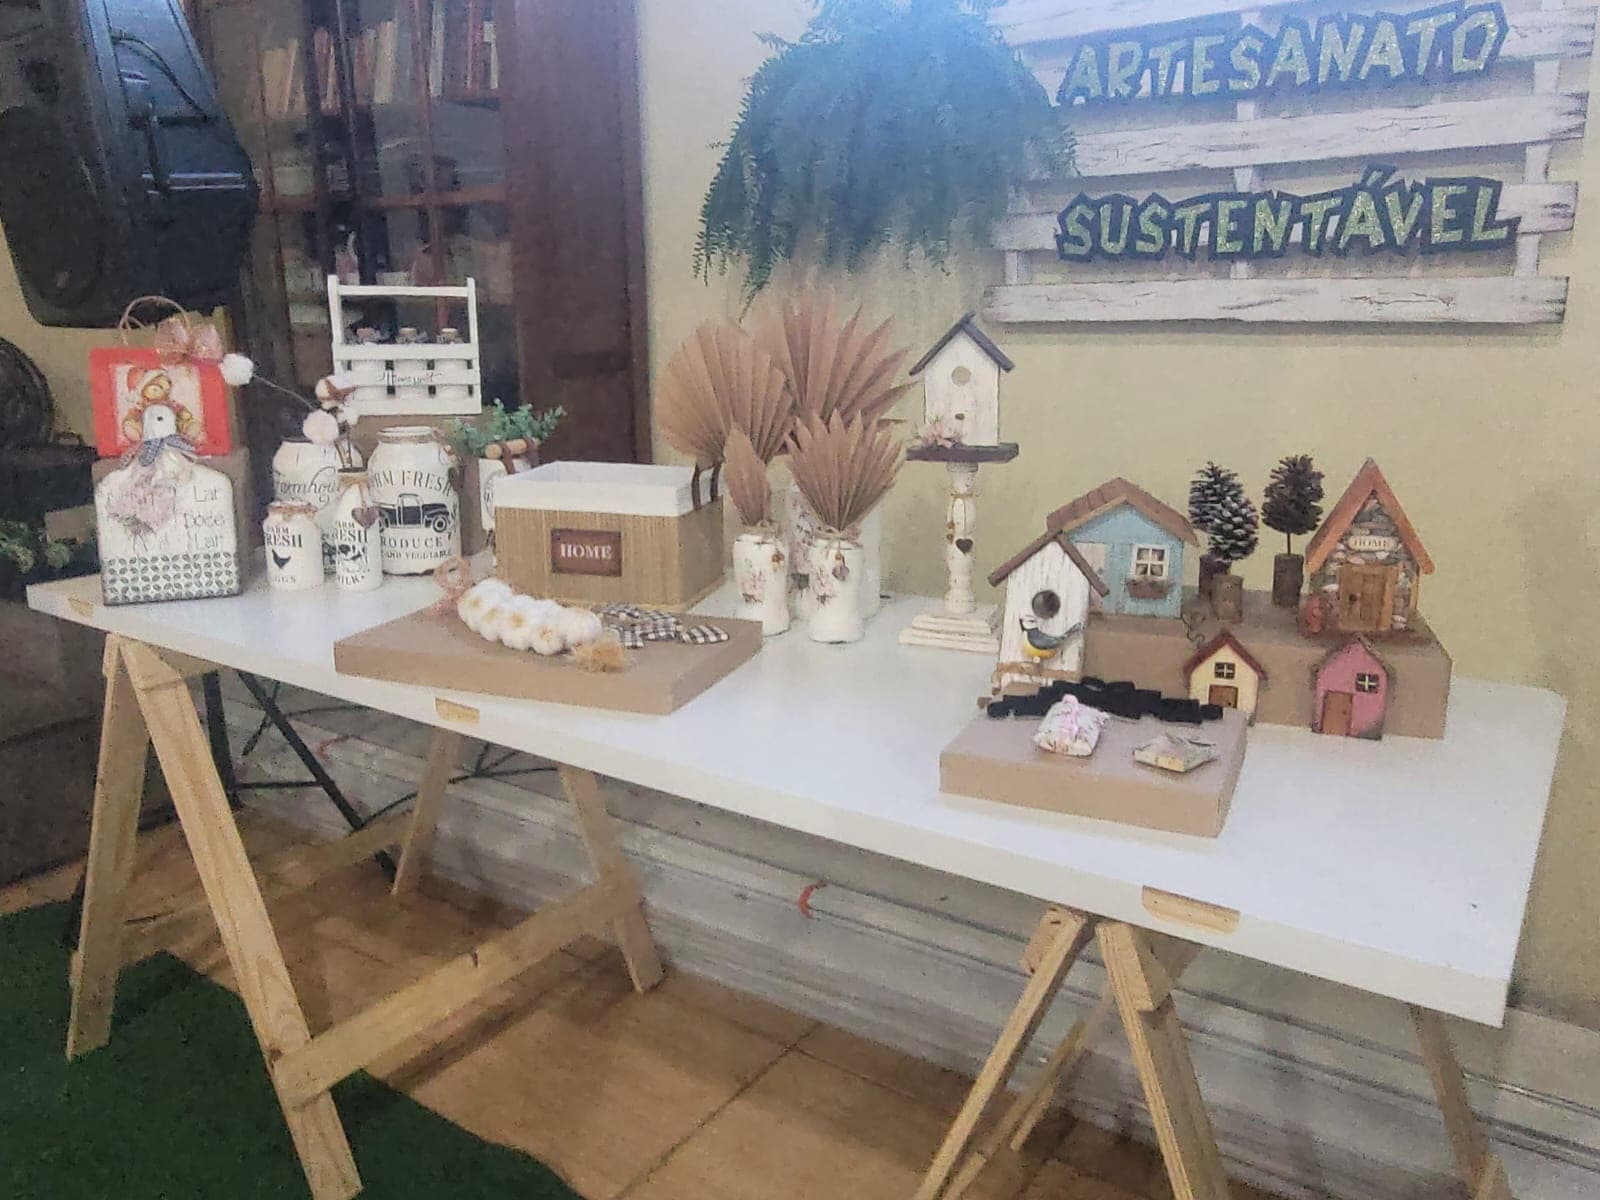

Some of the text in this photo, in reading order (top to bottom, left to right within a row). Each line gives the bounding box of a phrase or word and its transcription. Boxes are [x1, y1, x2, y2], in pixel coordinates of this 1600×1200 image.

[1061, 4, 1506, 104] ARTESANATO
[1056, 164, 1520, 259] SUSTENTÁVEL
[381, 536, 443, 549] RODUCE
[560, 543, 612, 559] HOME
